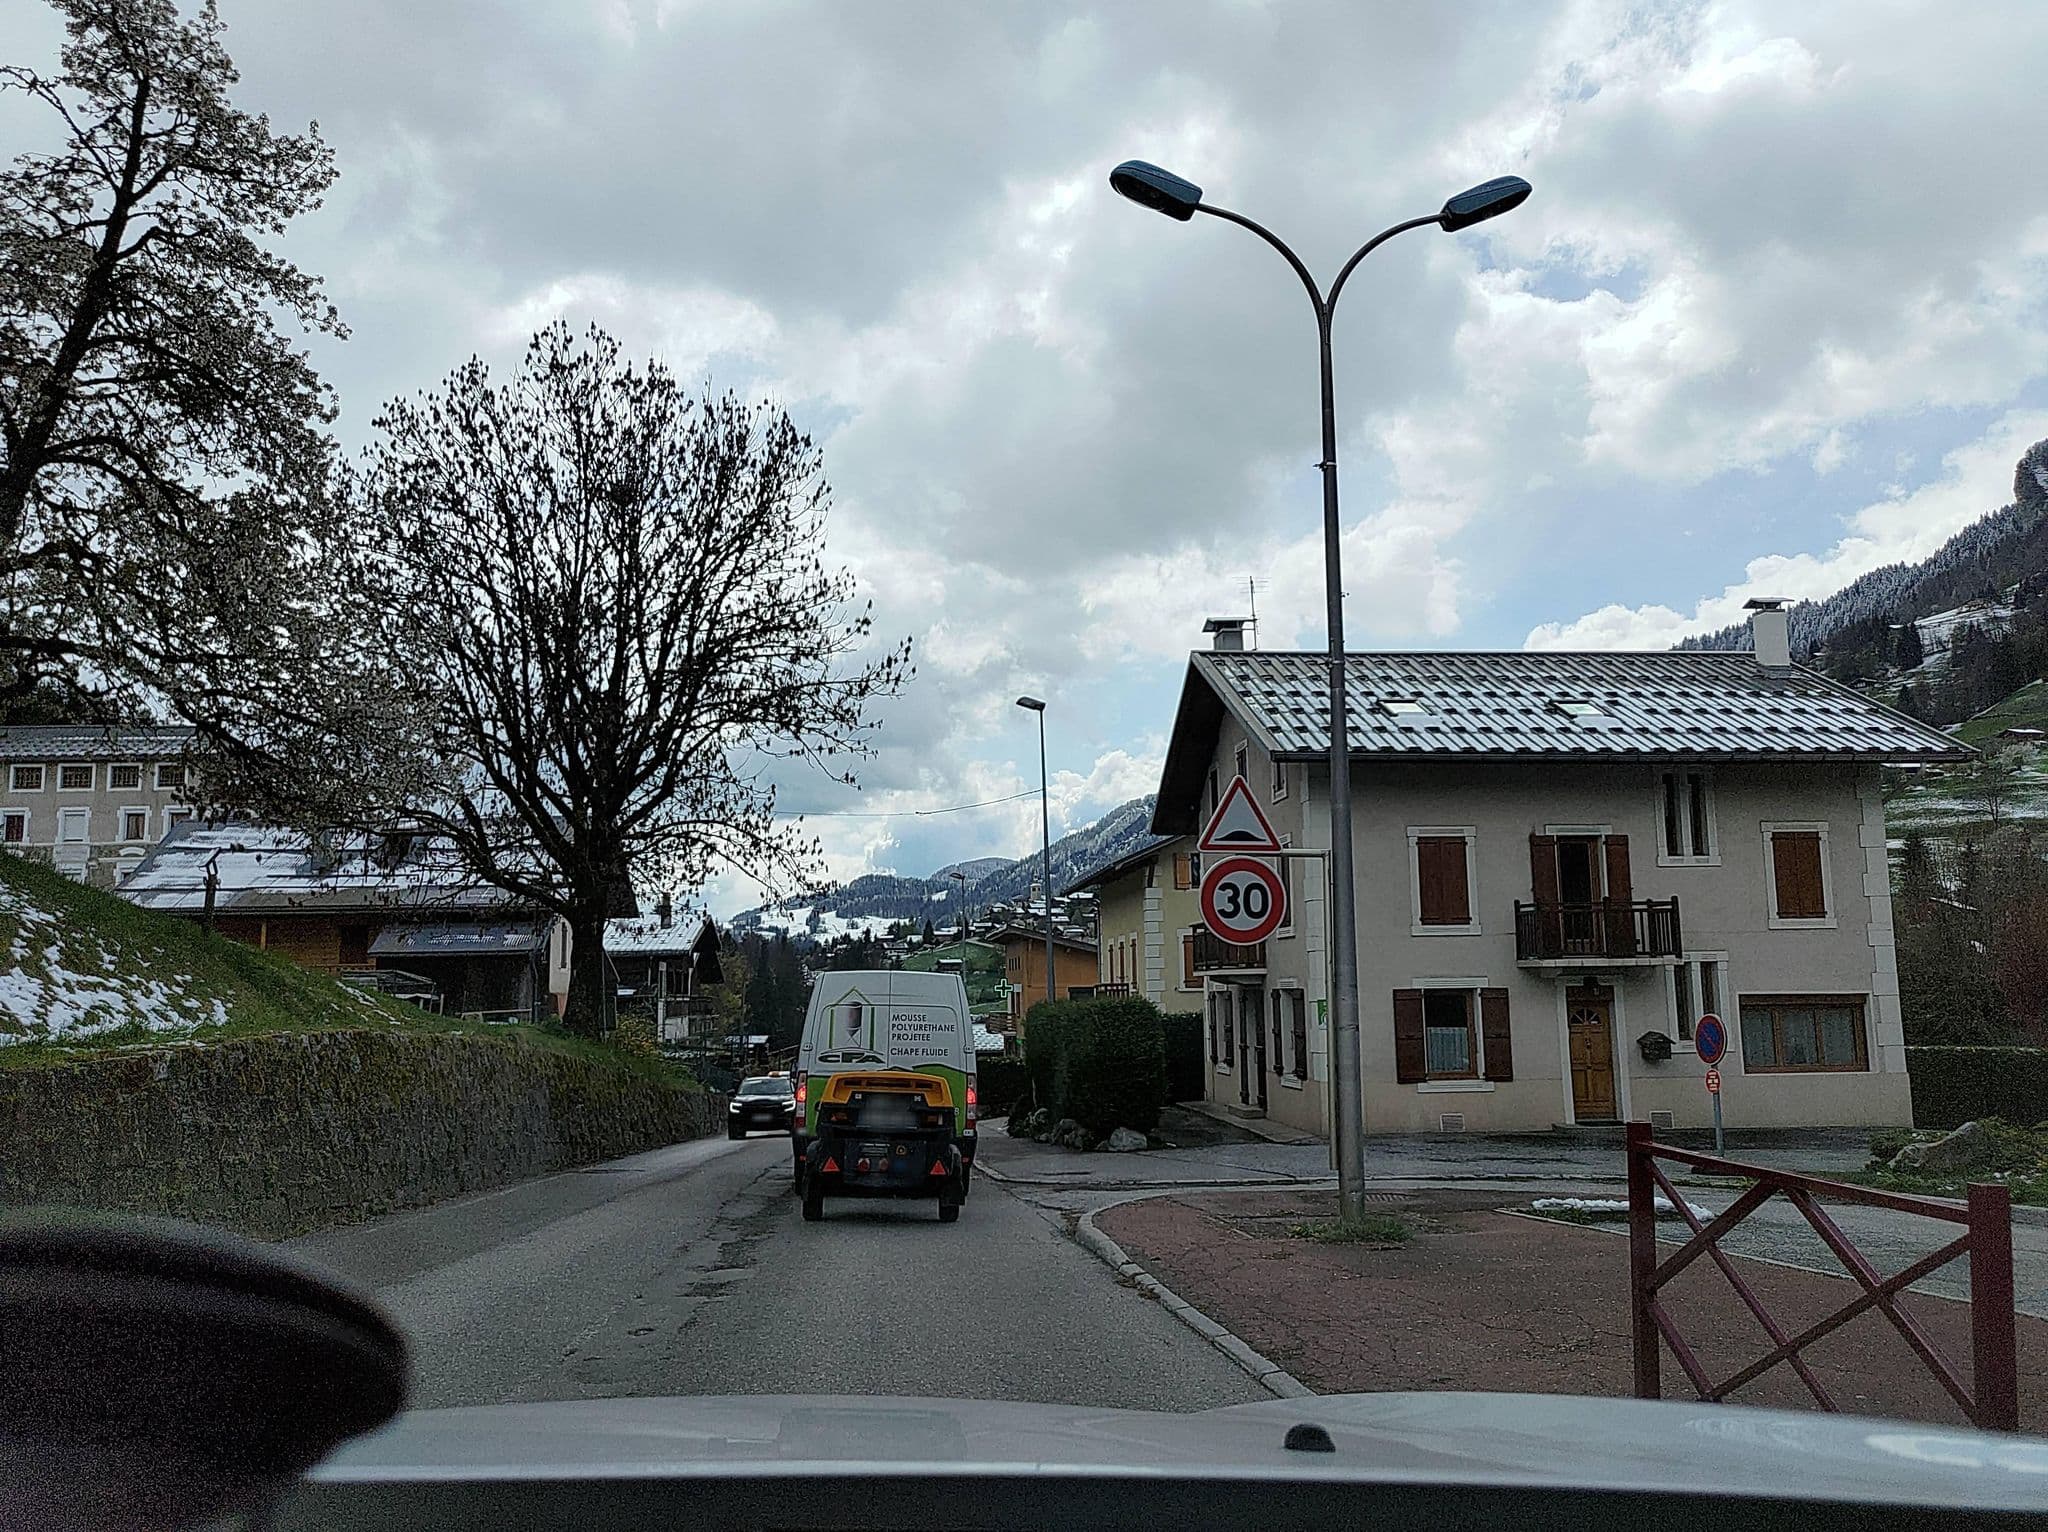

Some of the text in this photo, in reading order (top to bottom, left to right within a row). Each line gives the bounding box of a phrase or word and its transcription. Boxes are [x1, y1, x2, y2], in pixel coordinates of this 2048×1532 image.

[1217, 882, 1269, 919] 30
[892, 1014, 927, 1022] MOUSSE
[891, 1023, 955, 1032] POLYURETHANE
[891, 1033, 931, 1041] PROJETEE
[890, 1047, 949, 1056] CHAPE FLUIDE
